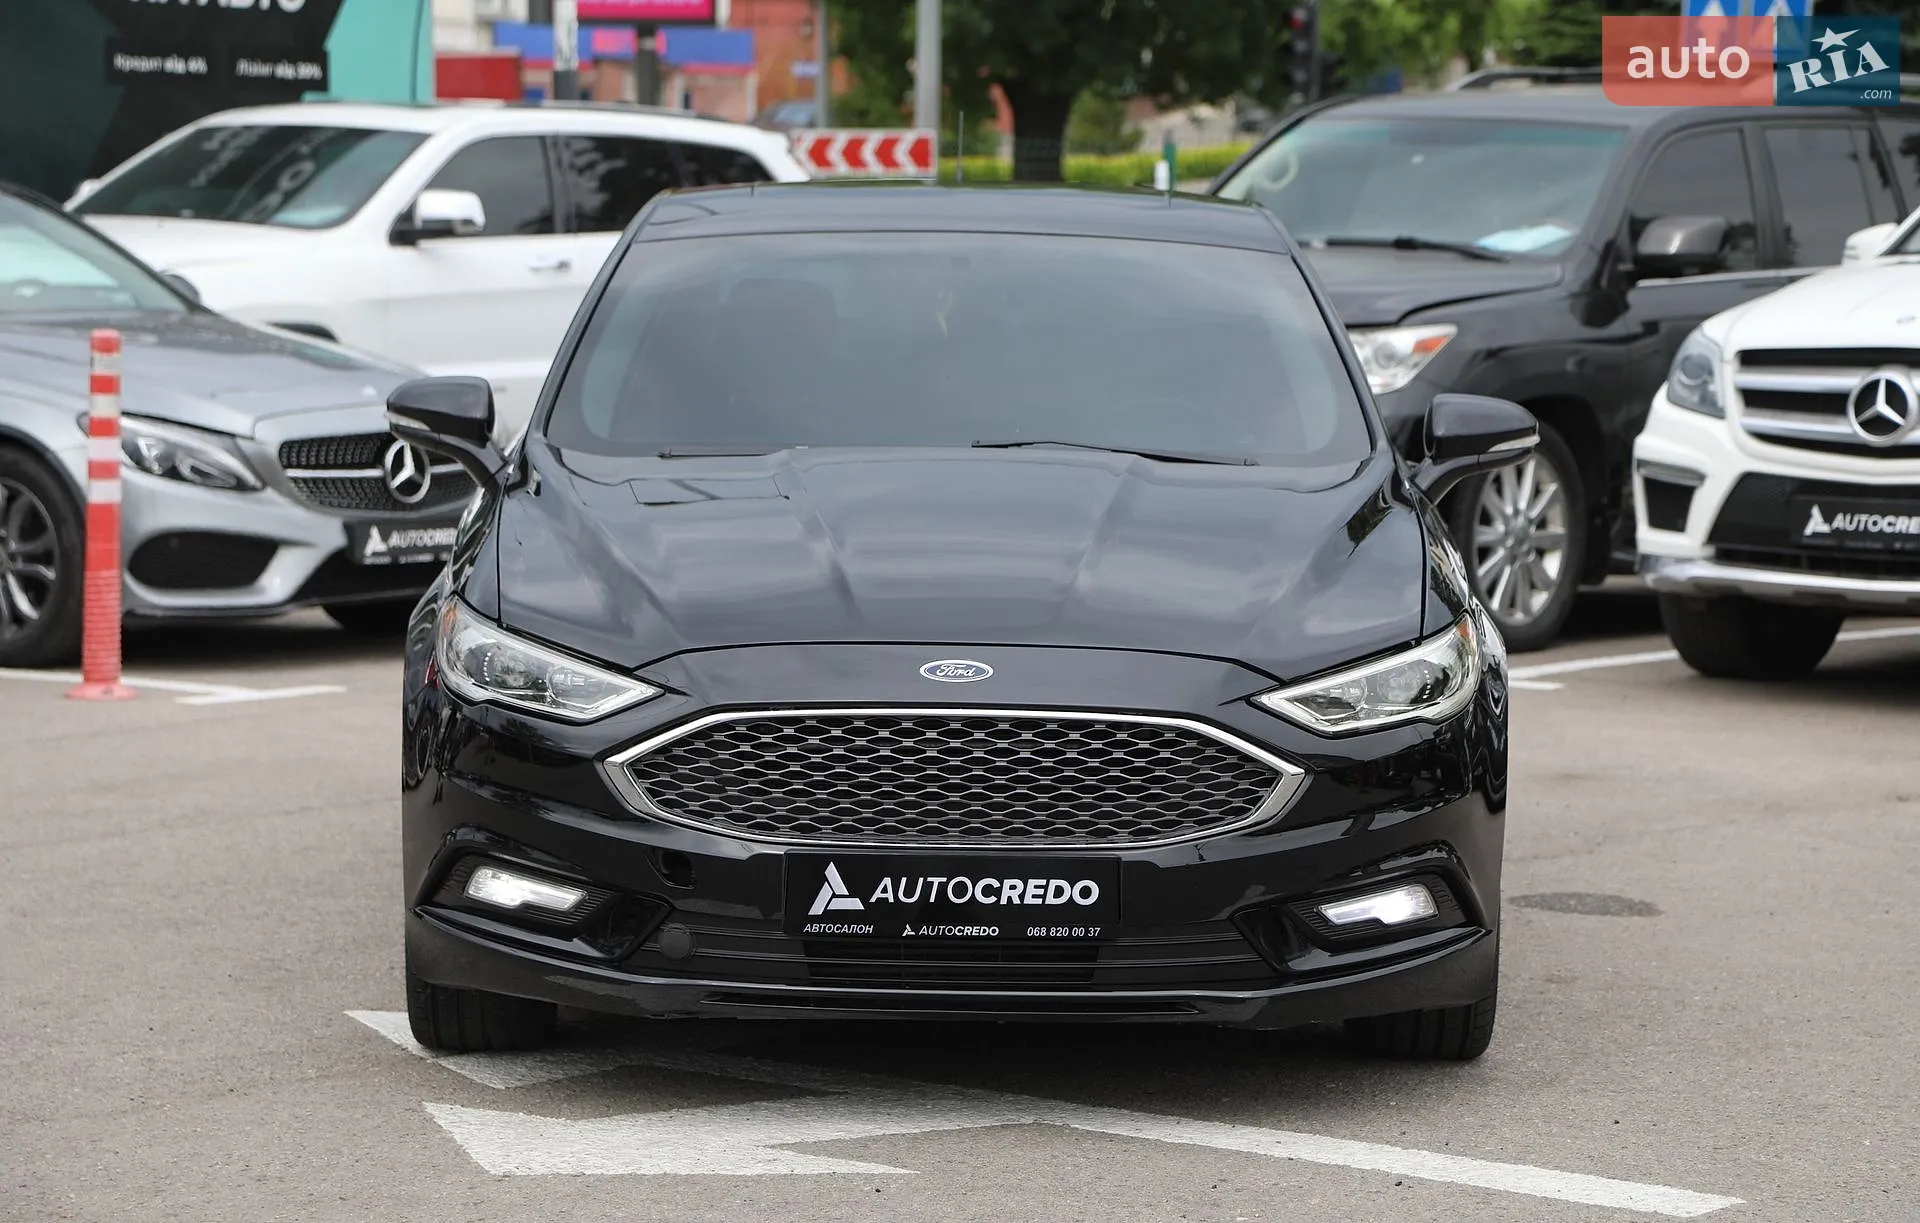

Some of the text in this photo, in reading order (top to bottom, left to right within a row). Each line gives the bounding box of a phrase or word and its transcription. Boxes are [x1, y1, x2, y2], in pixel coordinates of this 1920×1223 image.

[936, 663, 976, 677] Ford
[869, 876, 1100, 906] AUTOCREDO
[803, 923, 874, 934] АВТОСАЛОН
[918, 925, 999, 937] AUTOCREDO
[1027, 927, 1101, 938] 068 820 00 37
